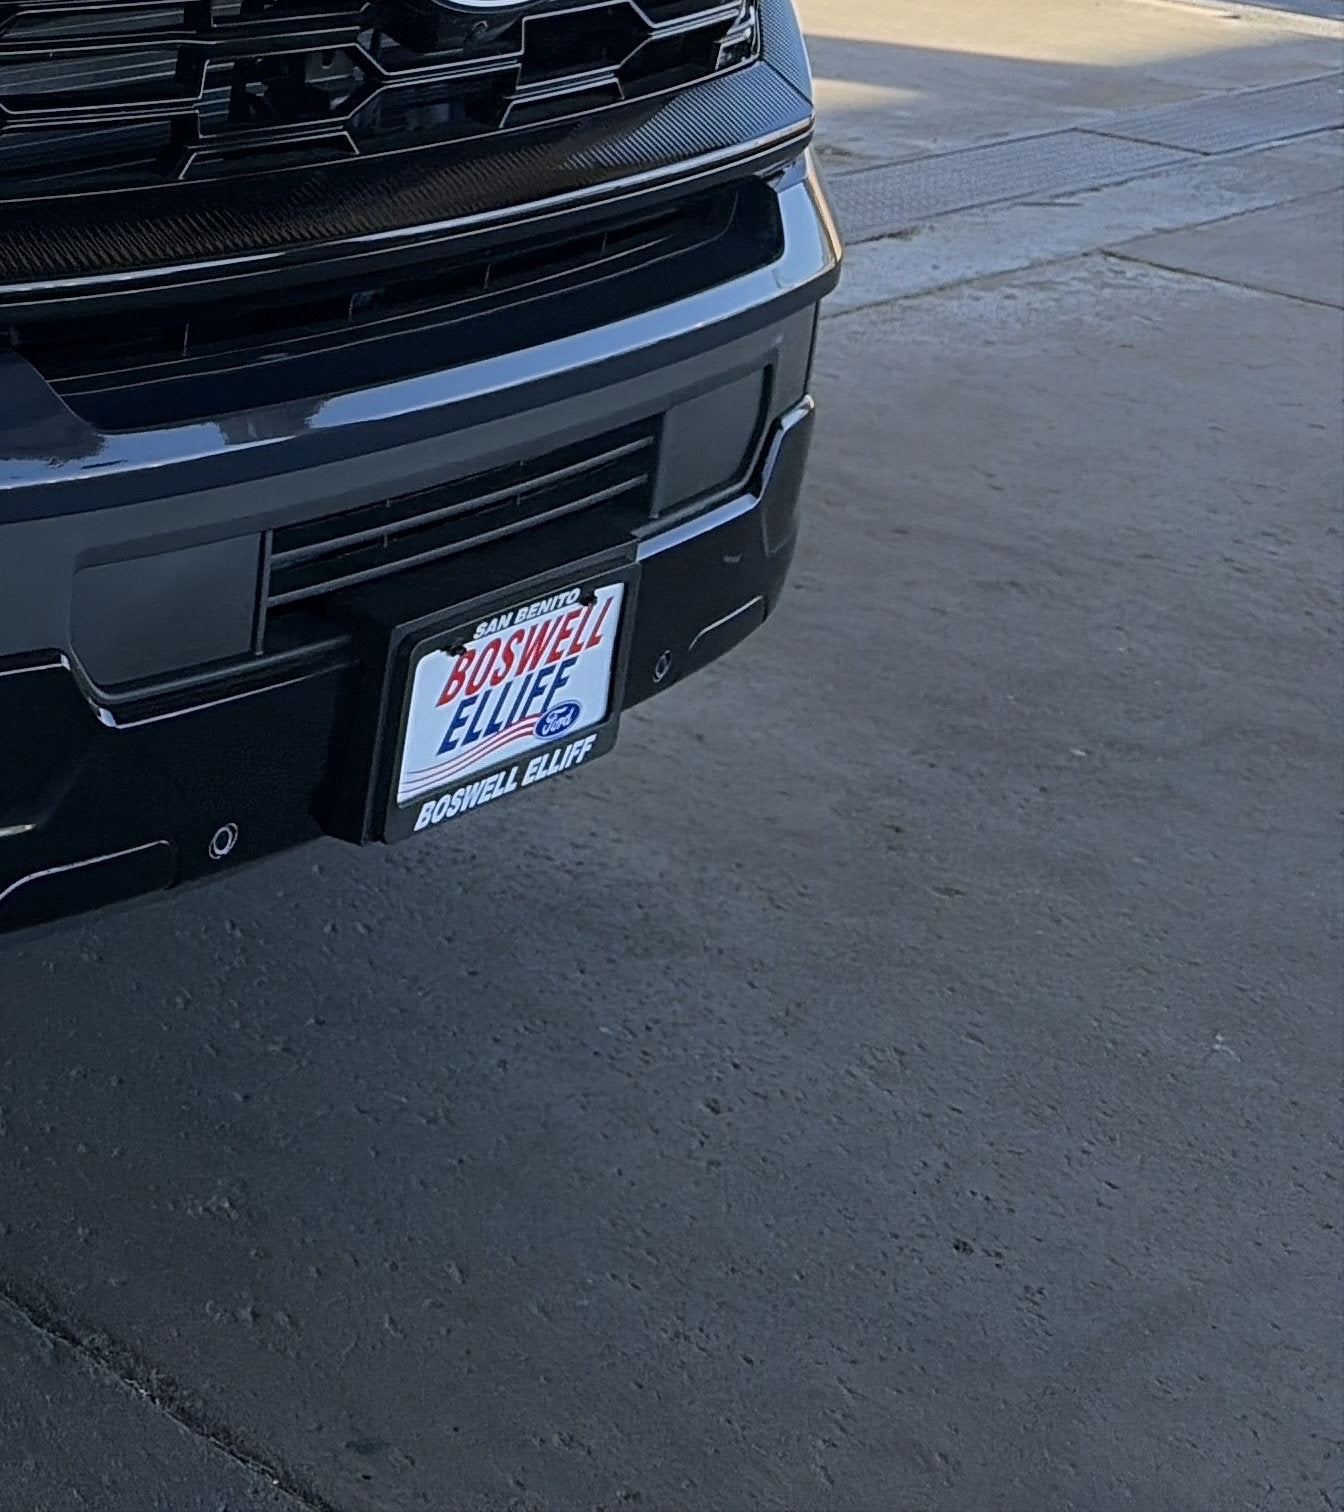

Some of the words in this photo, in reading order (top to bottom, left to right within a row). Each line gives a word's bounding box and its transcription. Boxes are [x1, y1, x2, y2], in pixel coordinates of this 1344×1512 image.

[435, 596, 614, 708] BOSWELL
[473, 611, 512, 639] SAN
[514, 588, 581, 626] BENITO
[435, 655, 579, 756] ELLIFF
[541, 706, 574, 733] Ford
[413, 765, 519, 832] BOSWELL
[522, 734, 597, 787] ELLIFF
